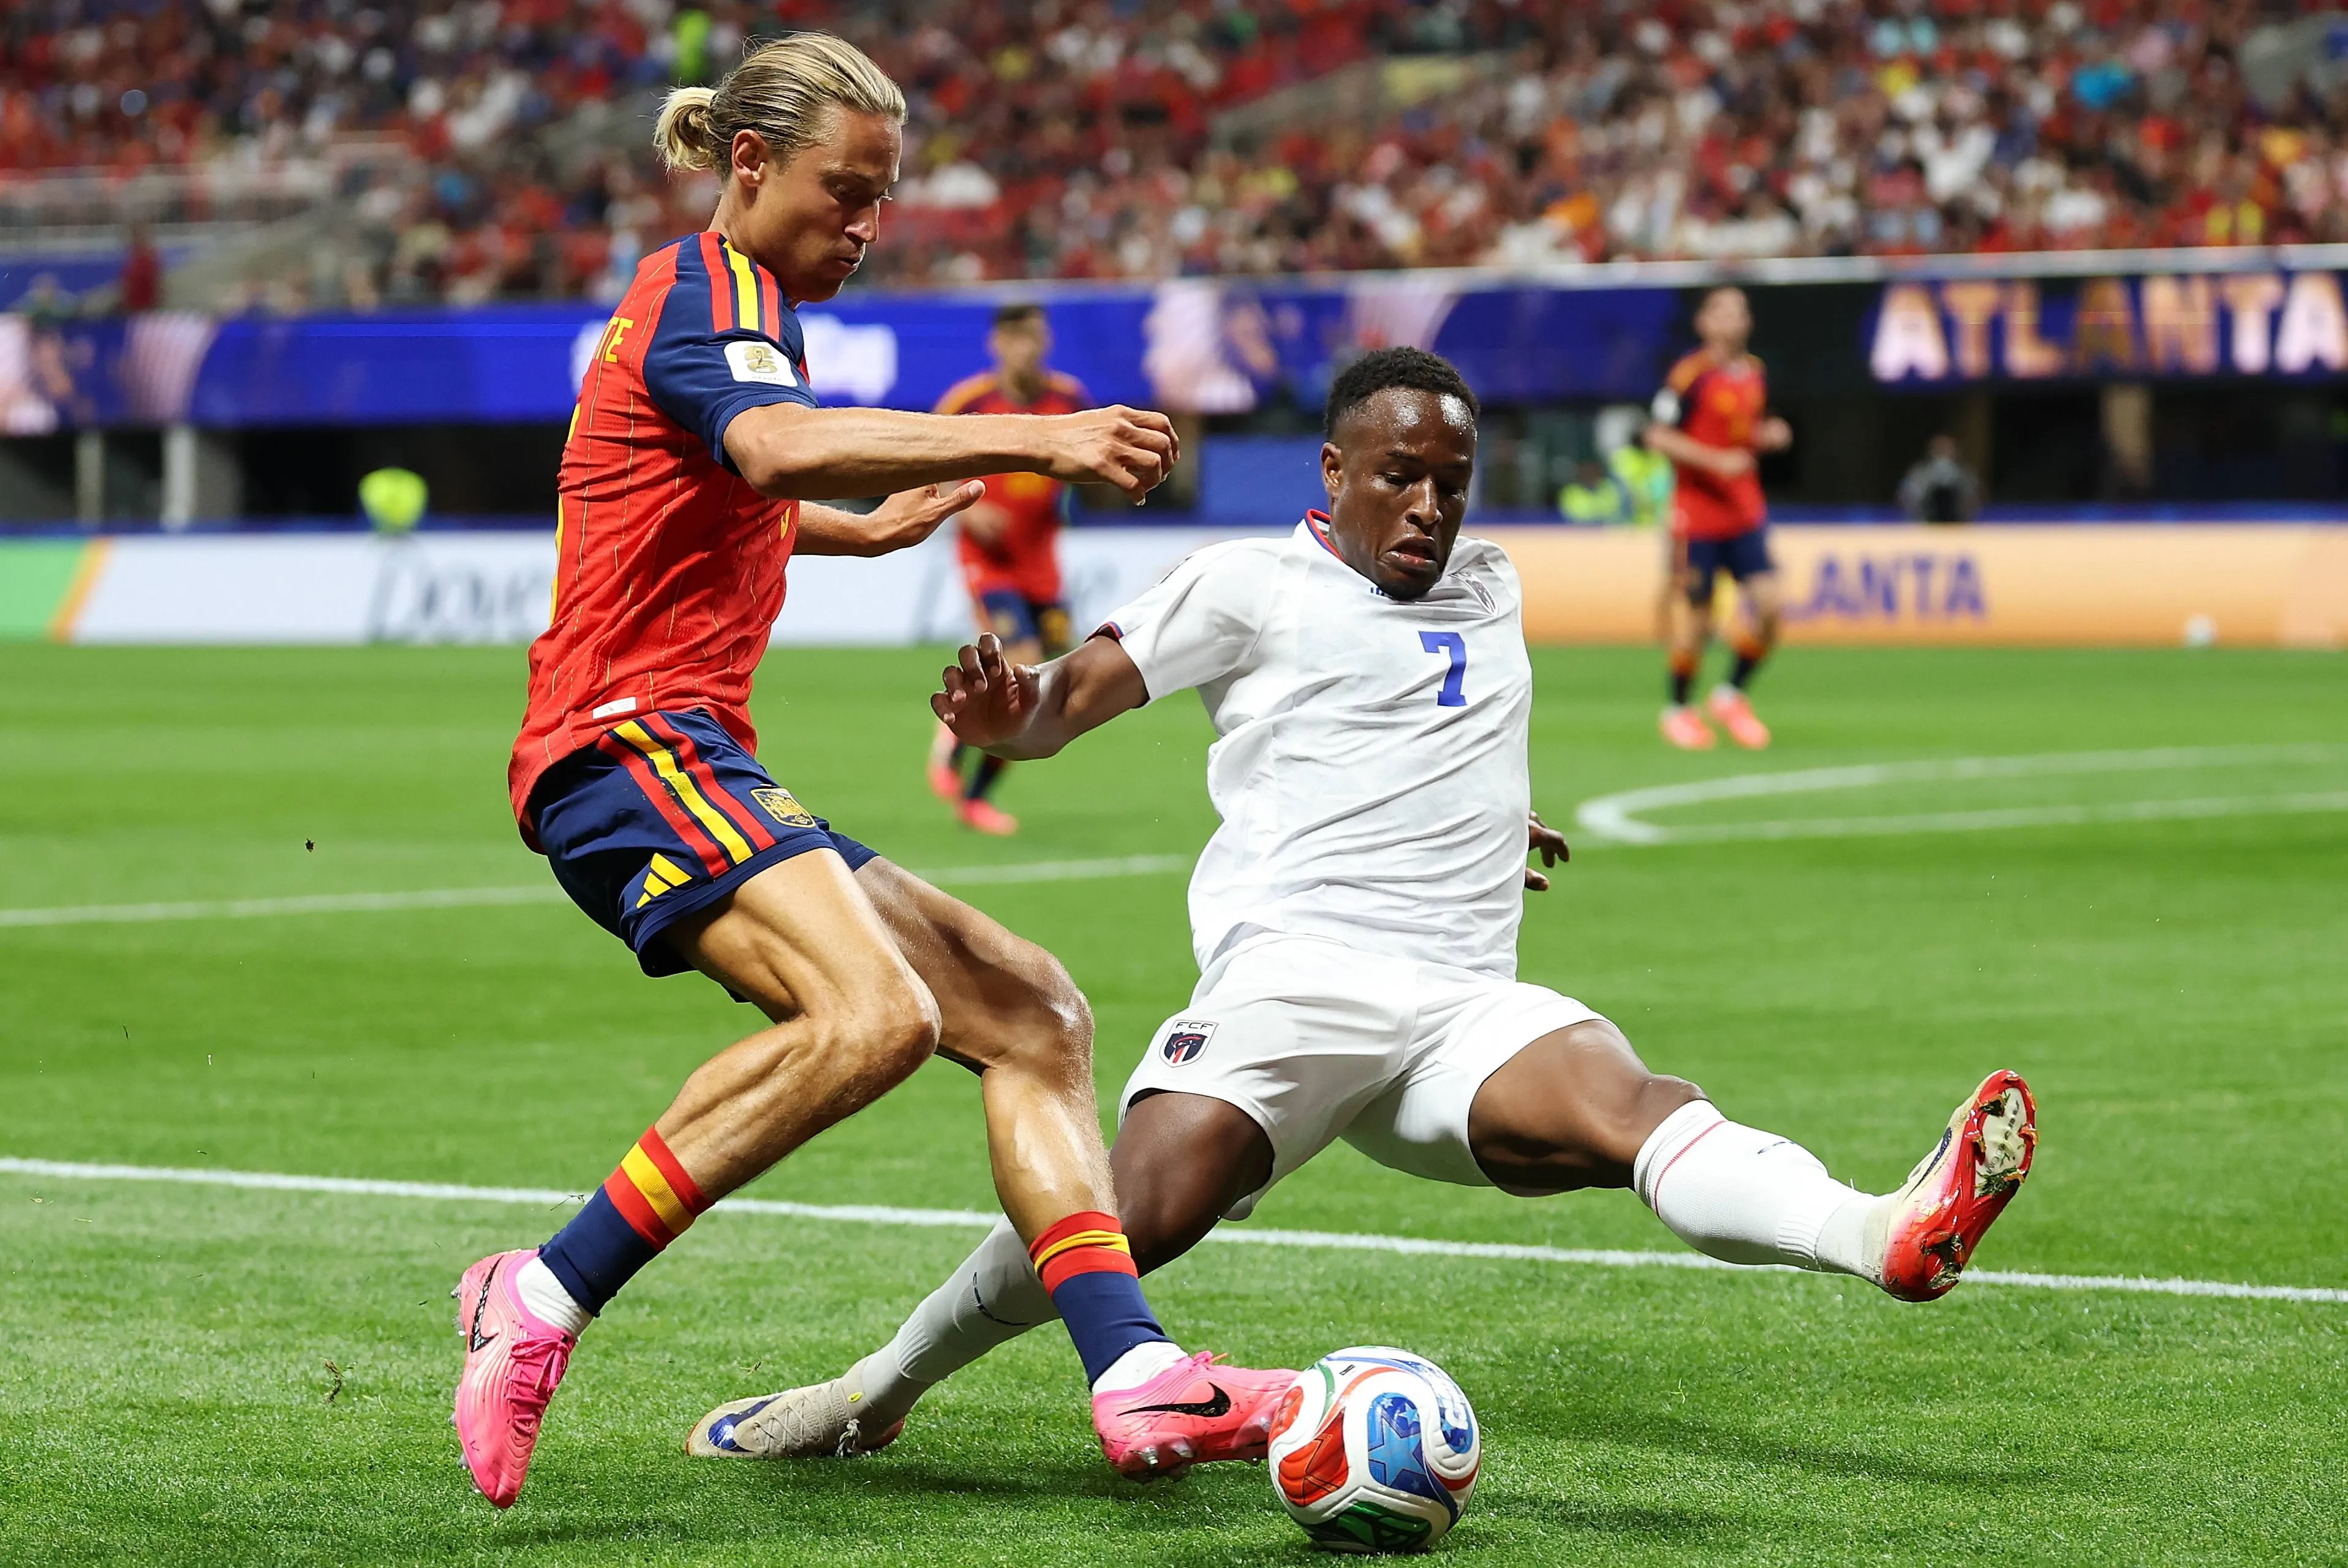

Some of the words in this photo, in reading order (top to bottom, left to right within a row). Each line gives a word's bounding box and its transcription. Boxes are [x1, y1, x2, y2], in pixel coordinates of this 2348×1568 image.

[595, 316, 634, 363] TE
[1870, 273, 2348, 381] ATLANTA
[1780, 553, 1989, 620] ANTA
[1418, 630, 1468, 707] 7
